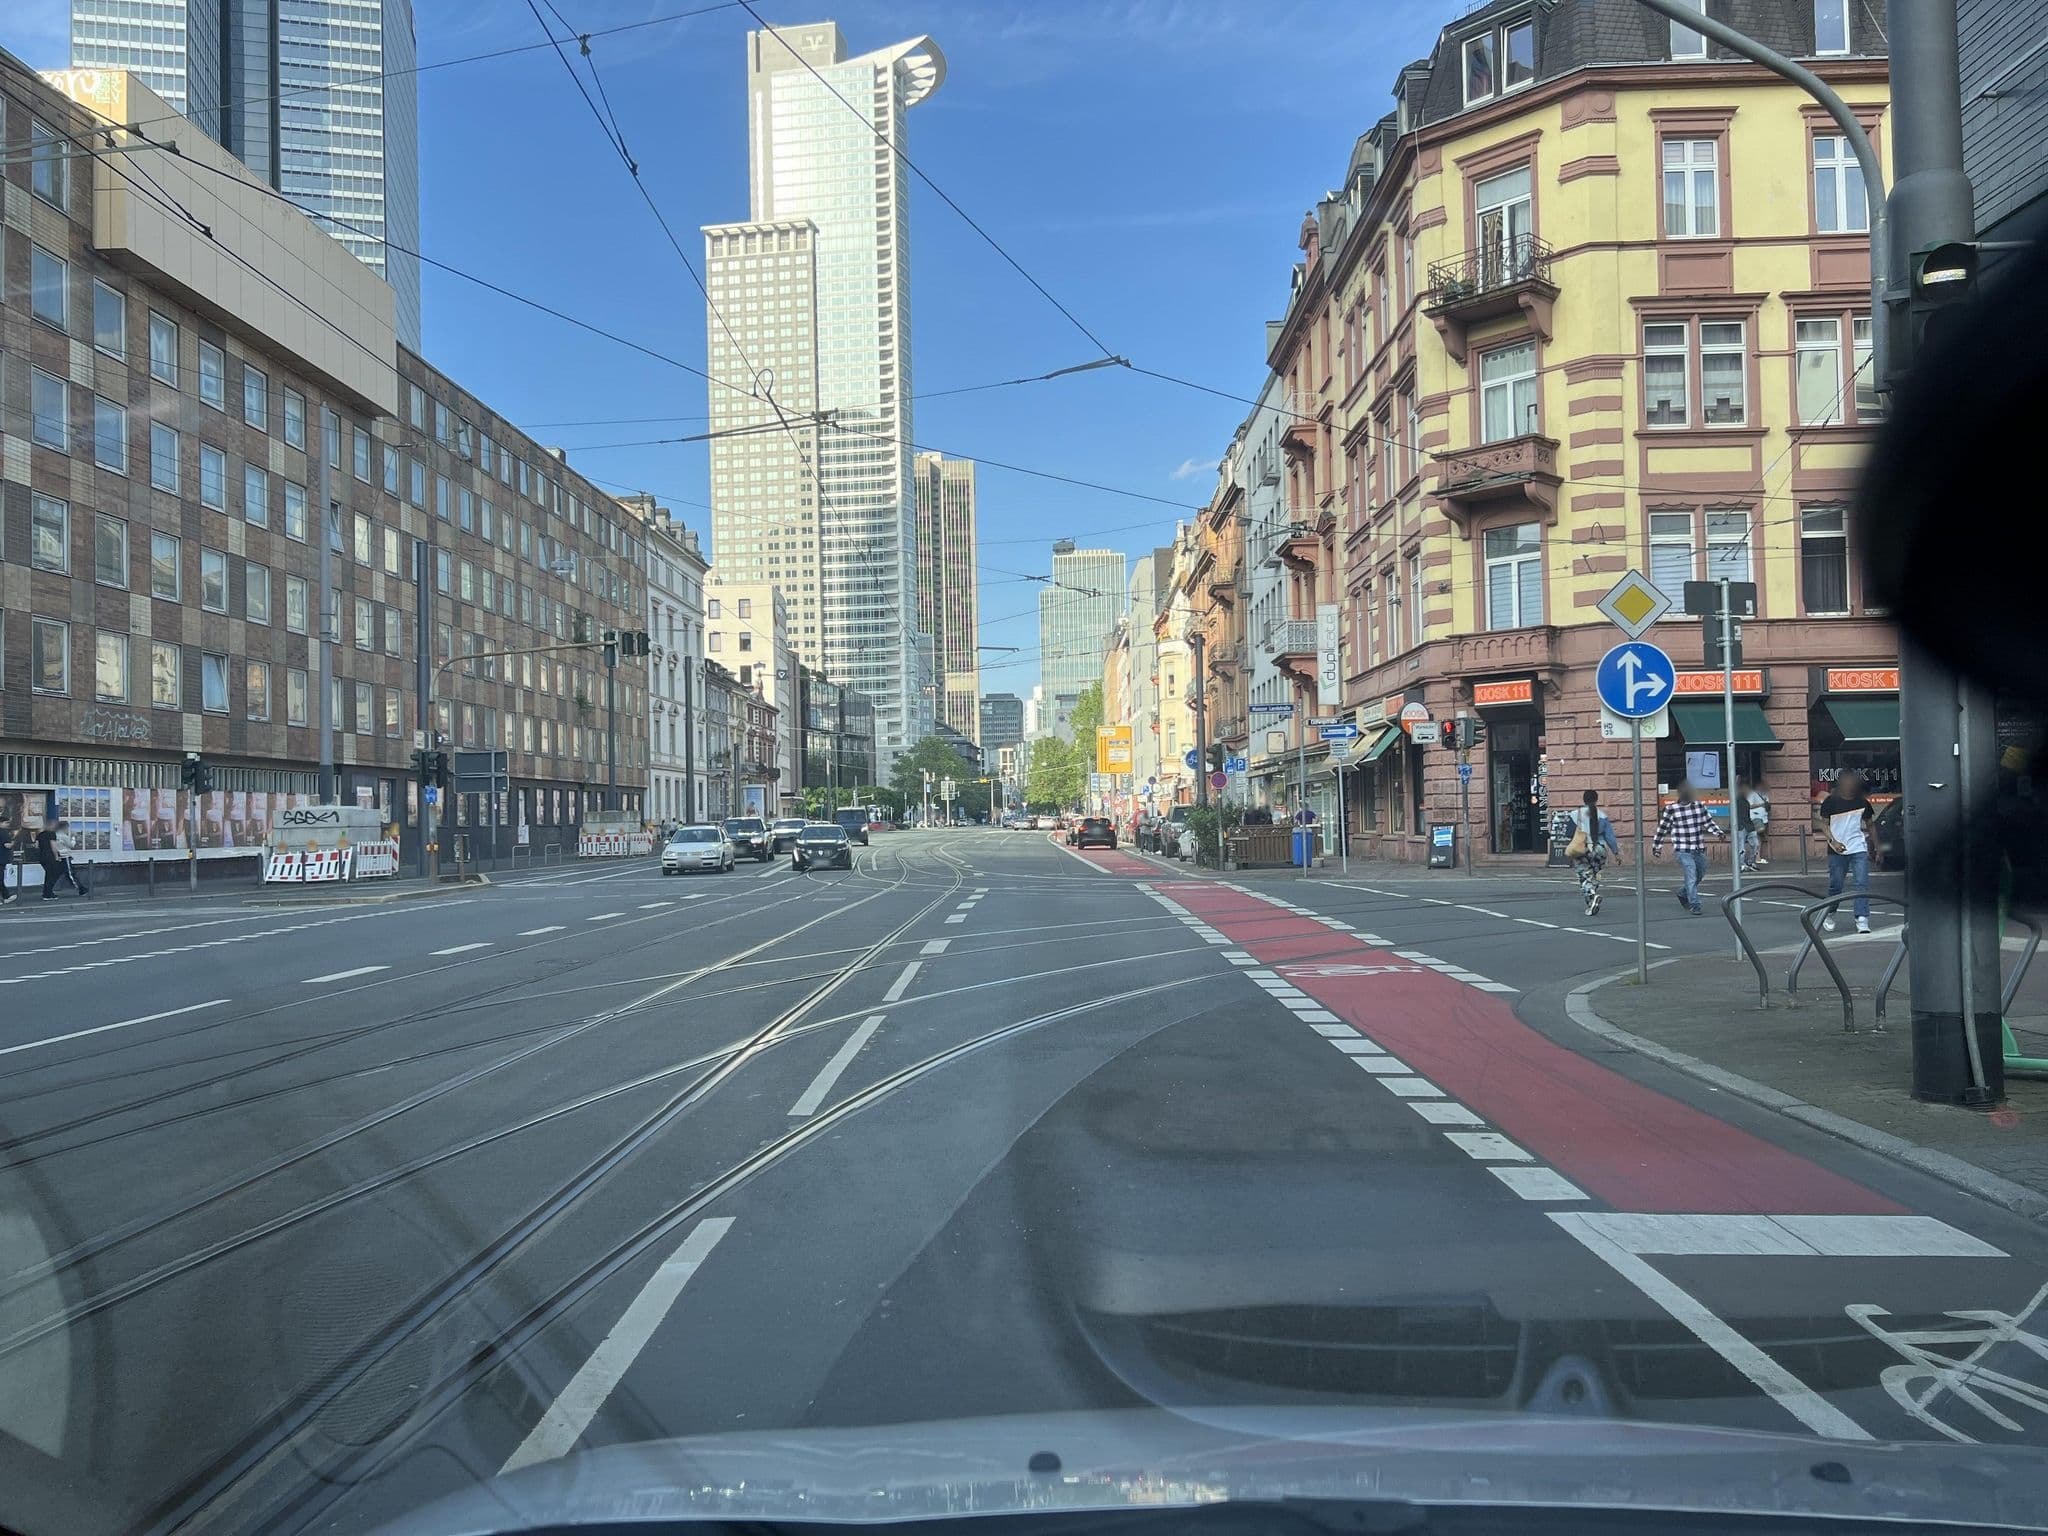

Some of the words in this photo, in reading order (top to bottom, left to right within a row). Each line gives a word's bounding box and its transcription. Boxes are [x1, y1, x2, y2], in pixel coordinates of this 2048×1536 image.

[1322, 615, 1336, 681] duplicate
[1675, 674, 1726, 690] KIOSK
[1733, 674, 1761, 689] 111
[1829, 672, 1886, 688] KIOSK
[1476, 686, 1511, 701] KIOSK
[1512, 684, 1530, 699] 111
[1873, 767, 1898, 781] 111
